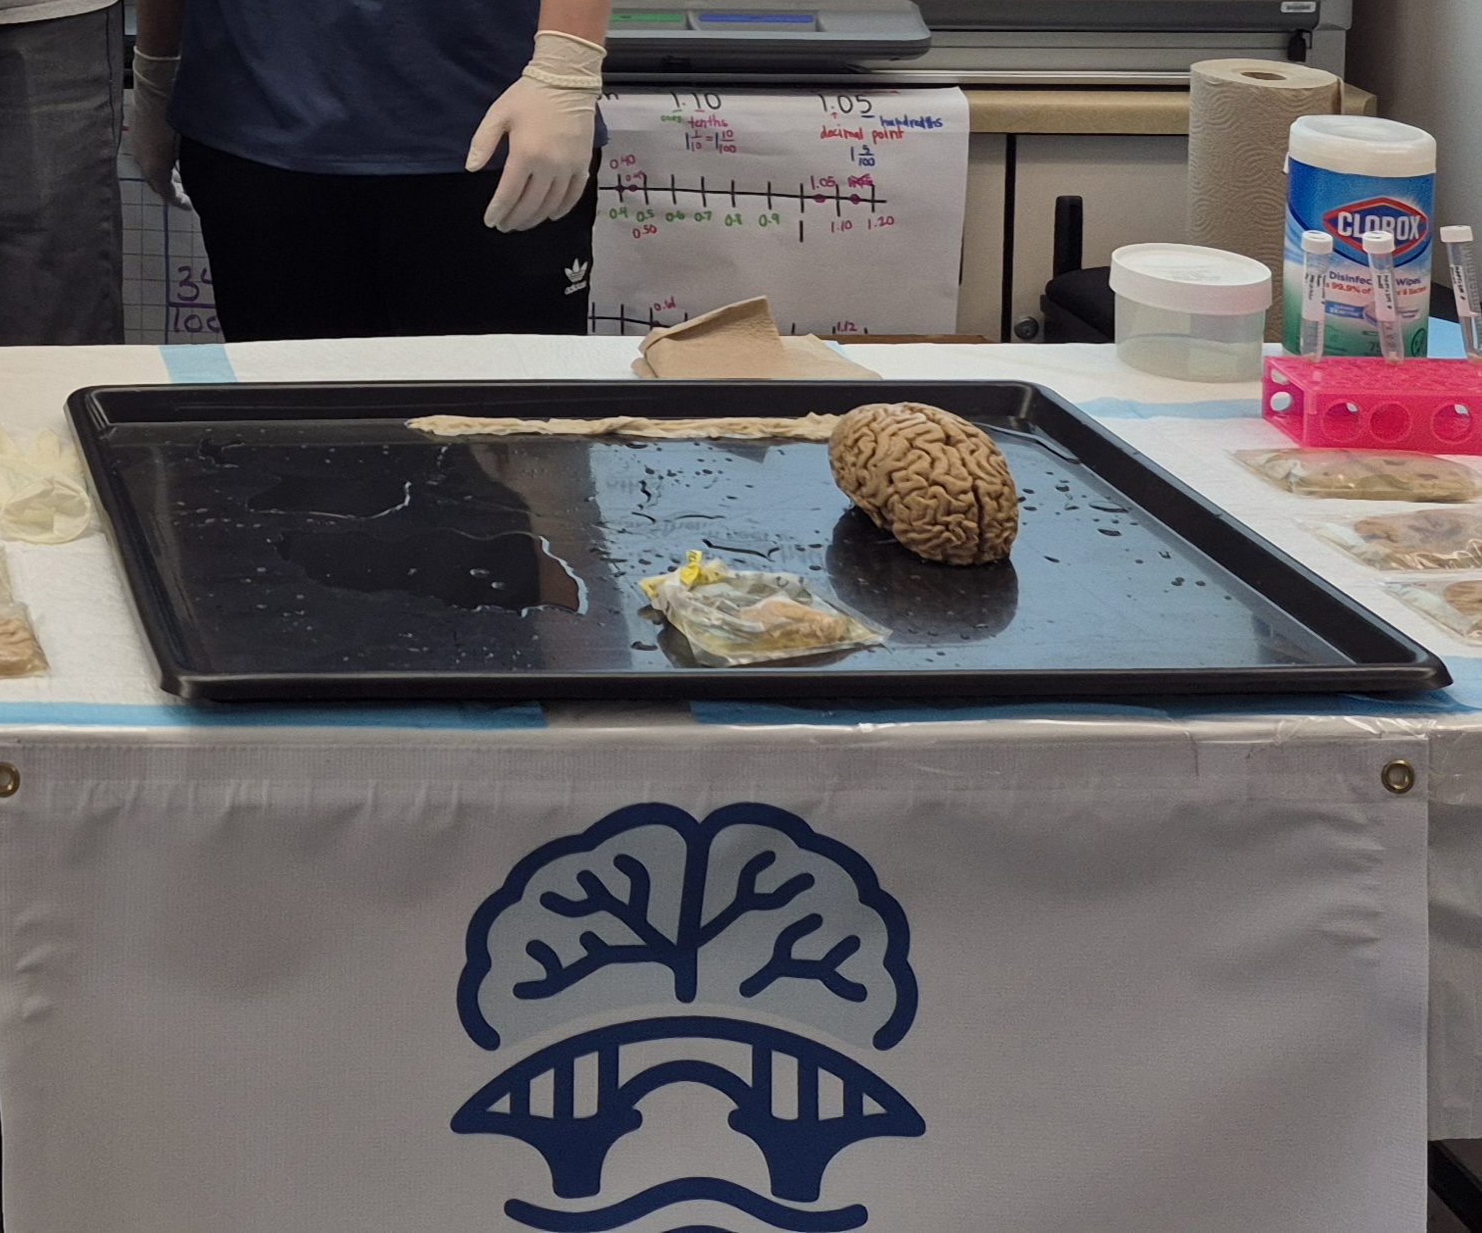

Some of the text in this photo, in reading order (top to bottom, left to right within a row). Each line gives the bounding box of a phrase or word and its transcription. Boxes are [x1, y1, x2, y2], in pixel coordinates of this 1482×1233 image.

[688, 116, 729, 129] tenths
[820, 125, 905, 142] decimal point
[831, 216, 895, 232] 1.10 1.20
[1396, 278, 1421, 286] Wipes
